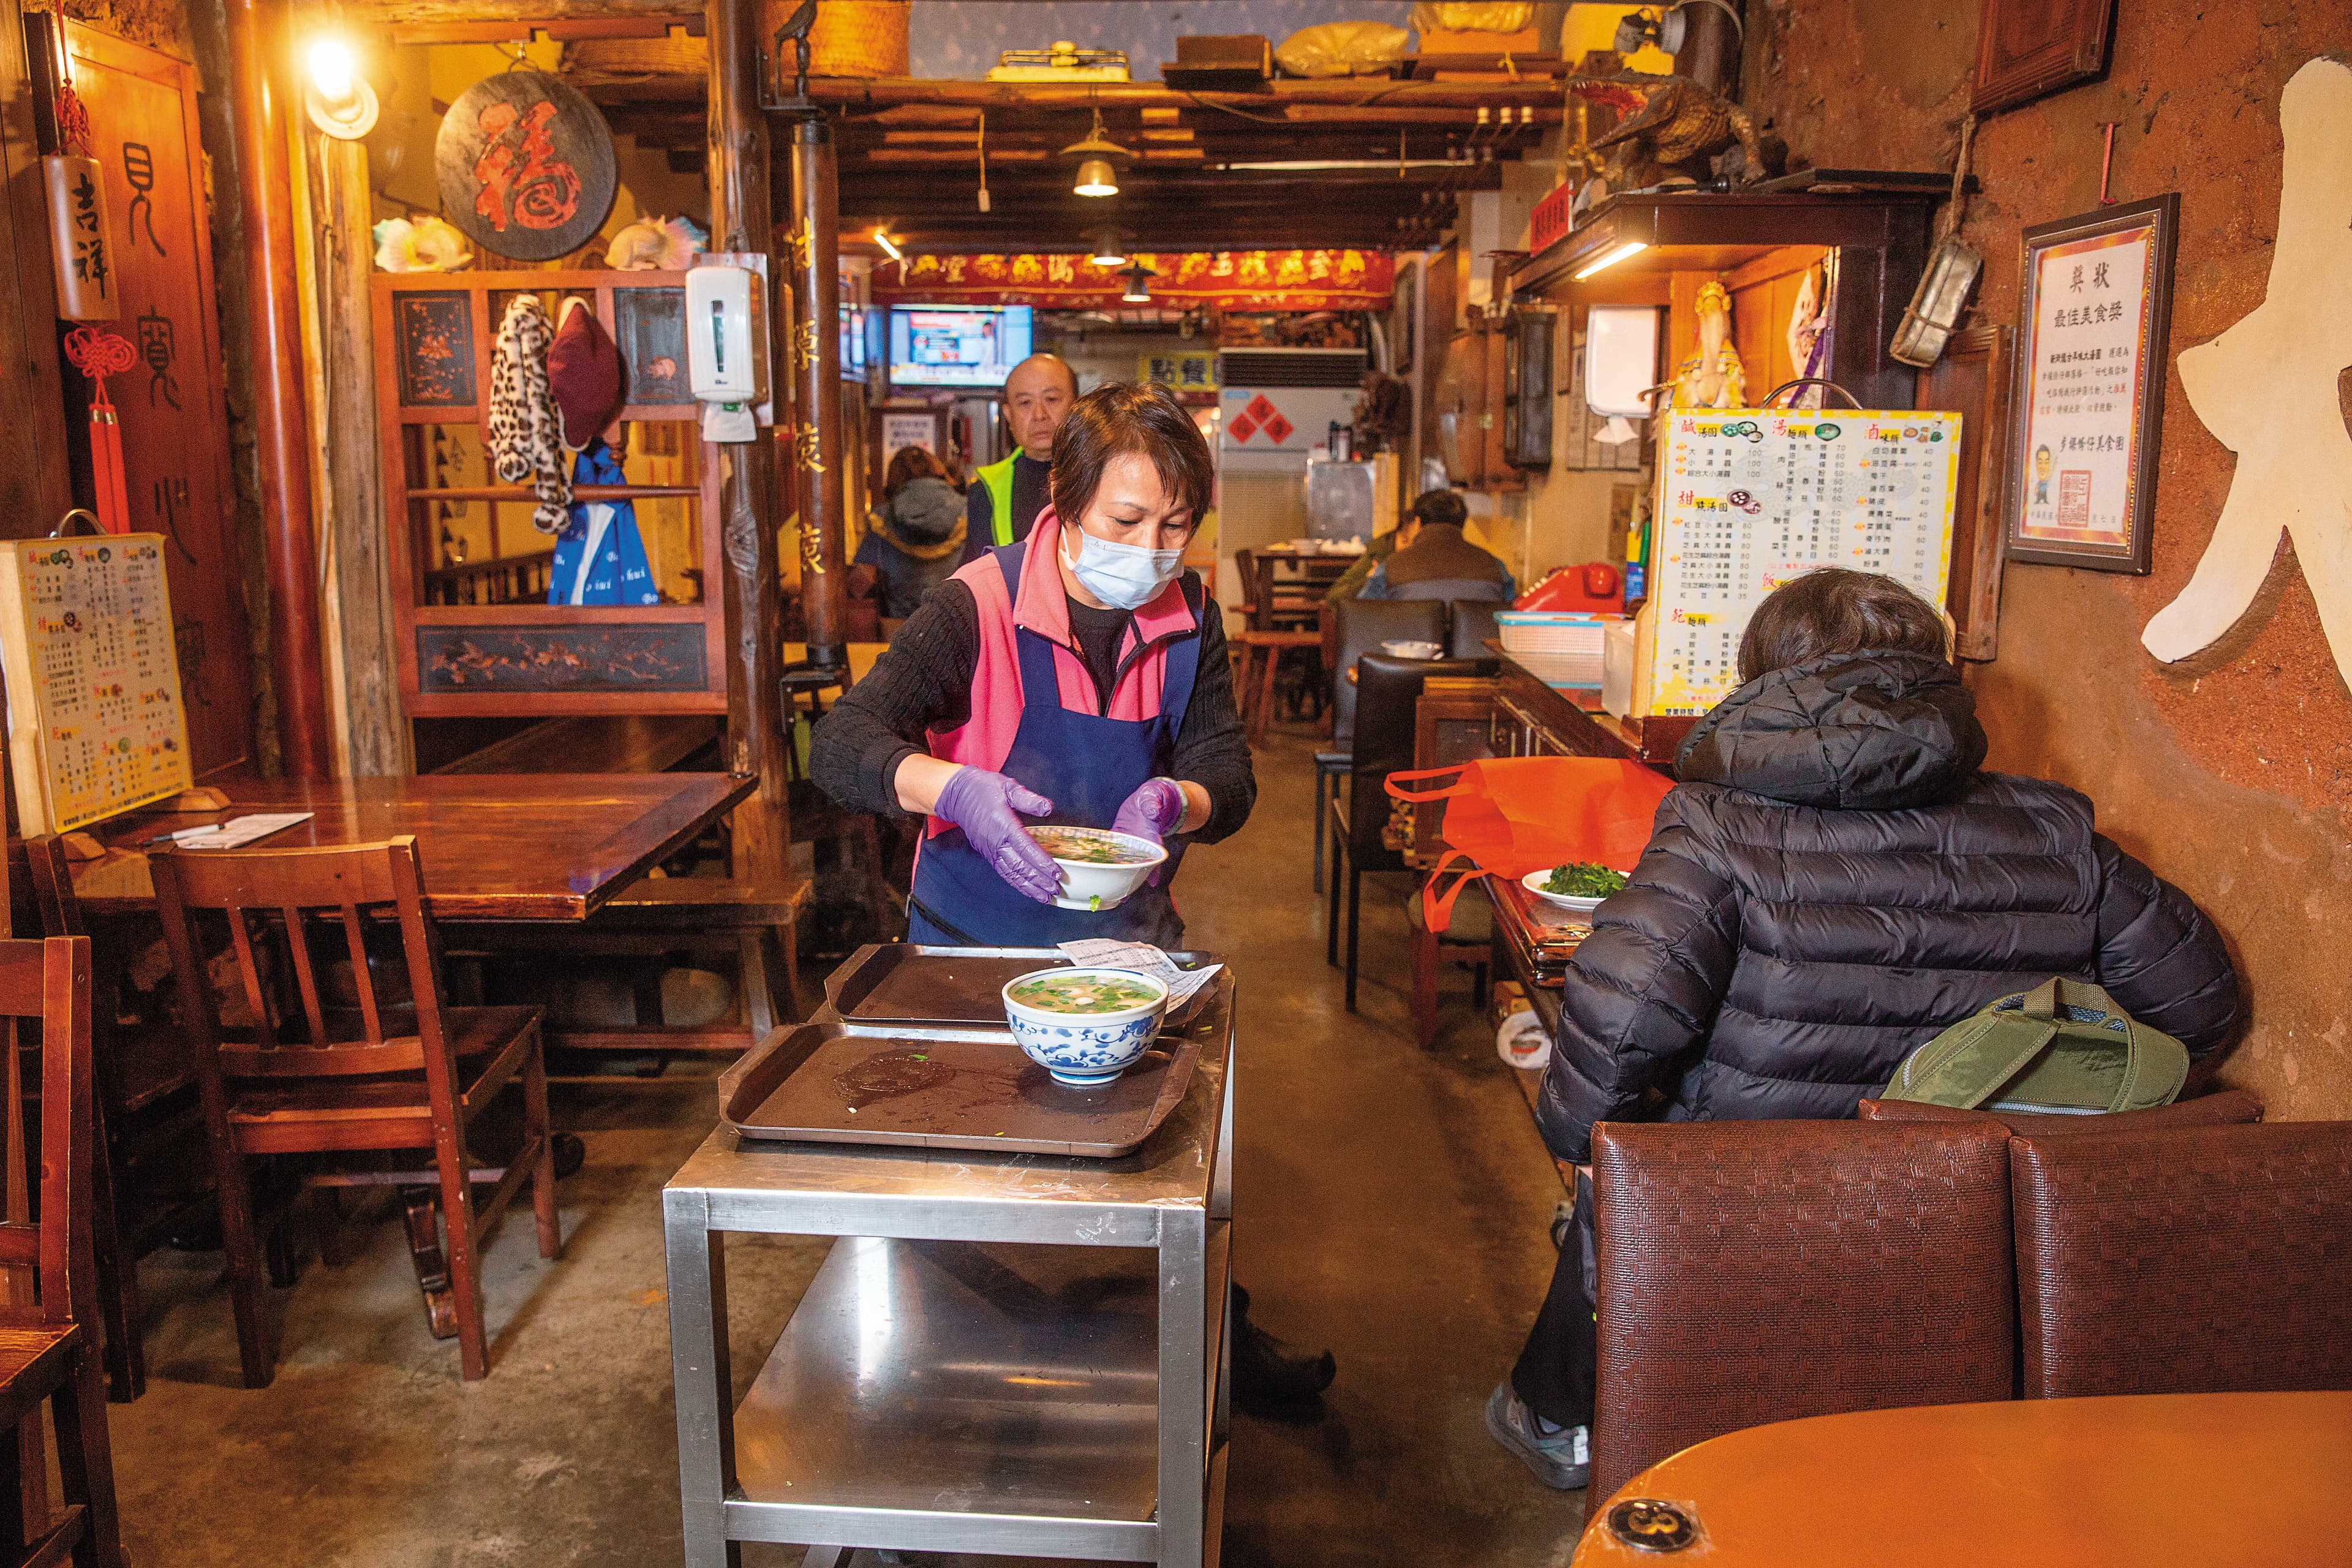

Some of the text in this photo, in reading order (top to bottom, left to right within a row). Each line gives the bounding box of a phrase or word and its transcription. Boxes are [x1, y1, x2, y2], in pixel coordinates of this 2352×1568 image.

[475, 100, 581, 232] 福
[66, 172, 108, 300] 吉祥
[2054, 301, 2122, 328] 最佳美食獎
